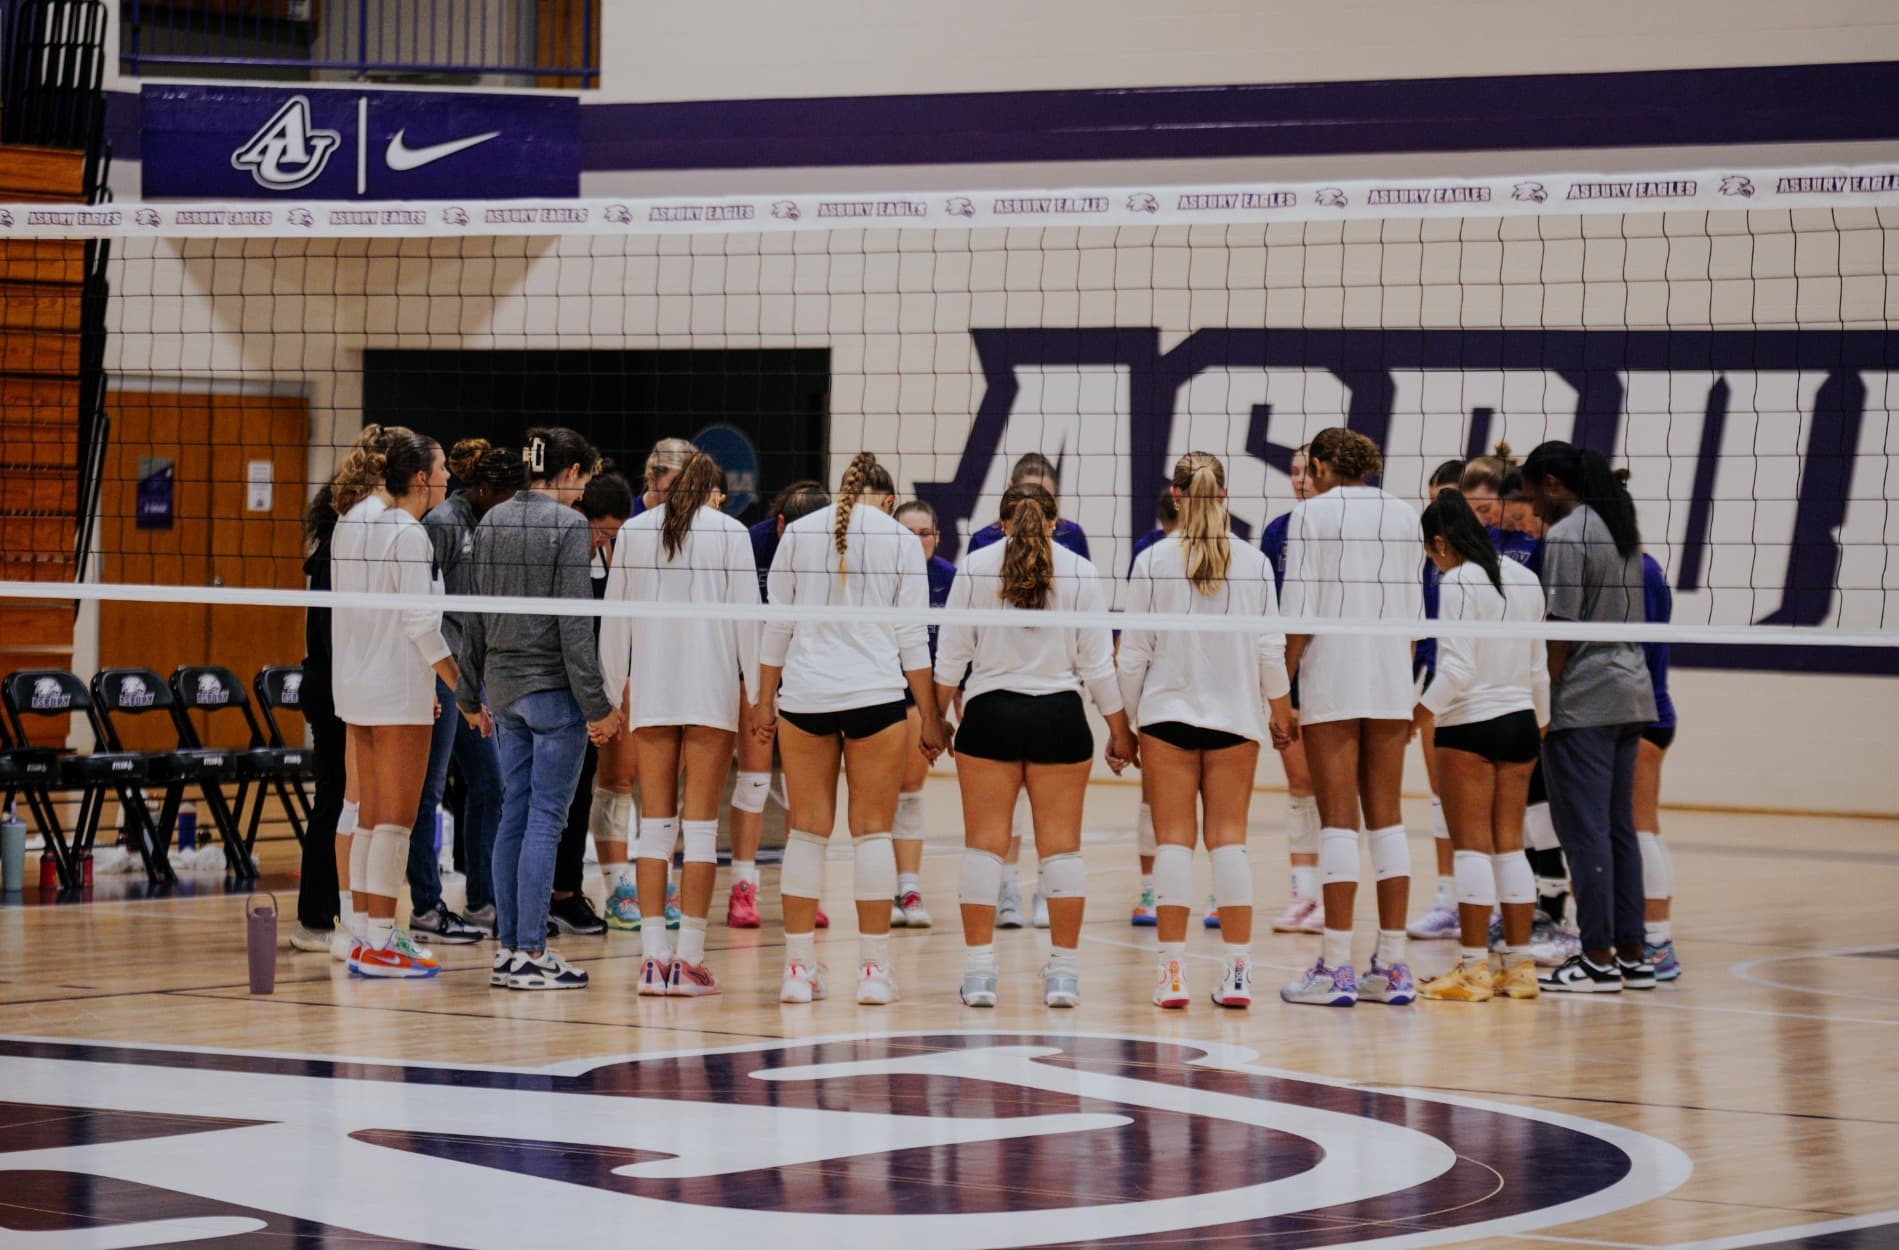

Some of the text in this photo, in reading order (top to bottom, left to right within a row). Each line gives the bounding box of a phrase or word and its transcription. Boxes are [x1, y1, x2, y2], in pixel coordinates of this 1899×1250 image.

[231, 95, 341, 190] AU
[1567, 181, 1697, 200] ASBURY EAGLES
[1776, 177, 1847, 193] ASBURY
[1177, 192, 1296, 210] ASBURY EAGLES
[1368, 187, 1491, 205] ASBURY EAGLES
